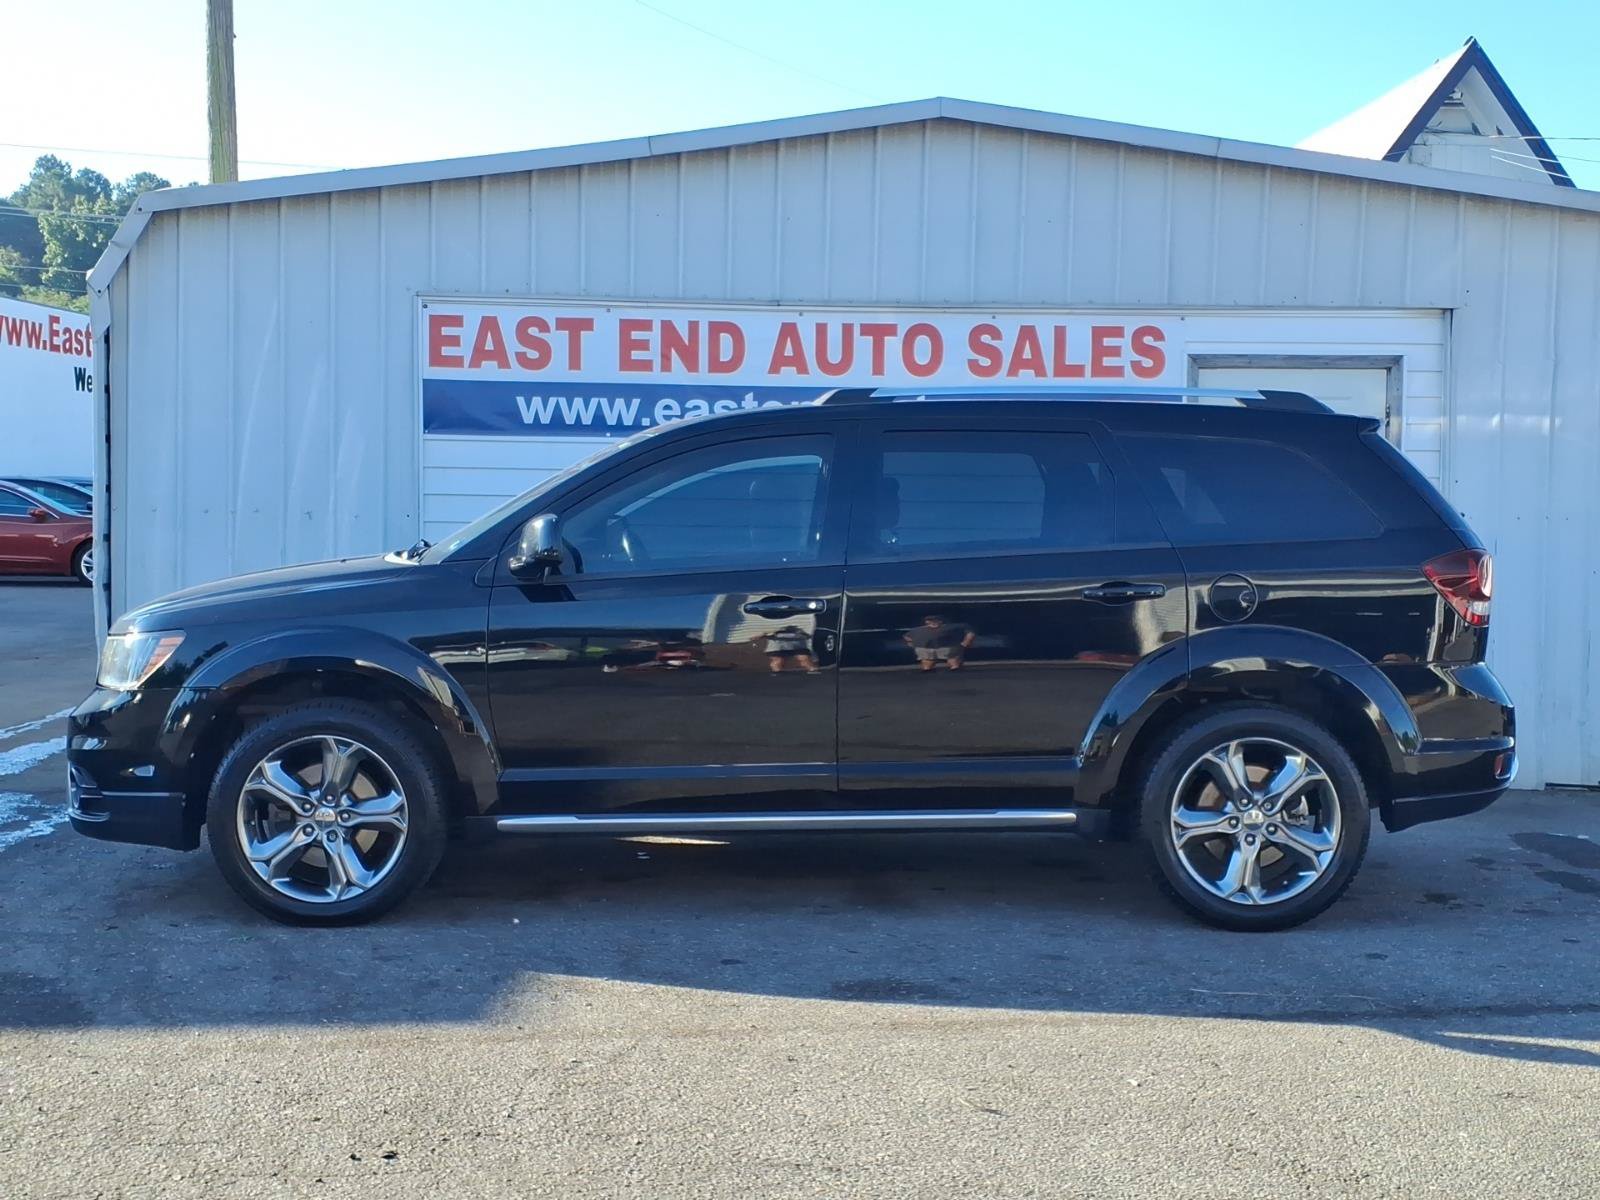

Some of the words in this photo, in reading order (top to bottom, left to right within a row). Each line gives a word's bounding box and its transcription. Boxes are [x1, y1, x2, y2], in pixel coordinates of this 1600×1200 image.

[429, 314, 593, 371] EAST
[619, 318, 746, 374] END
[767, 322, 944, 378] AUTO
[967, 323, 1166, 379] SALES
[516, 391, 815, 426] www.ea
